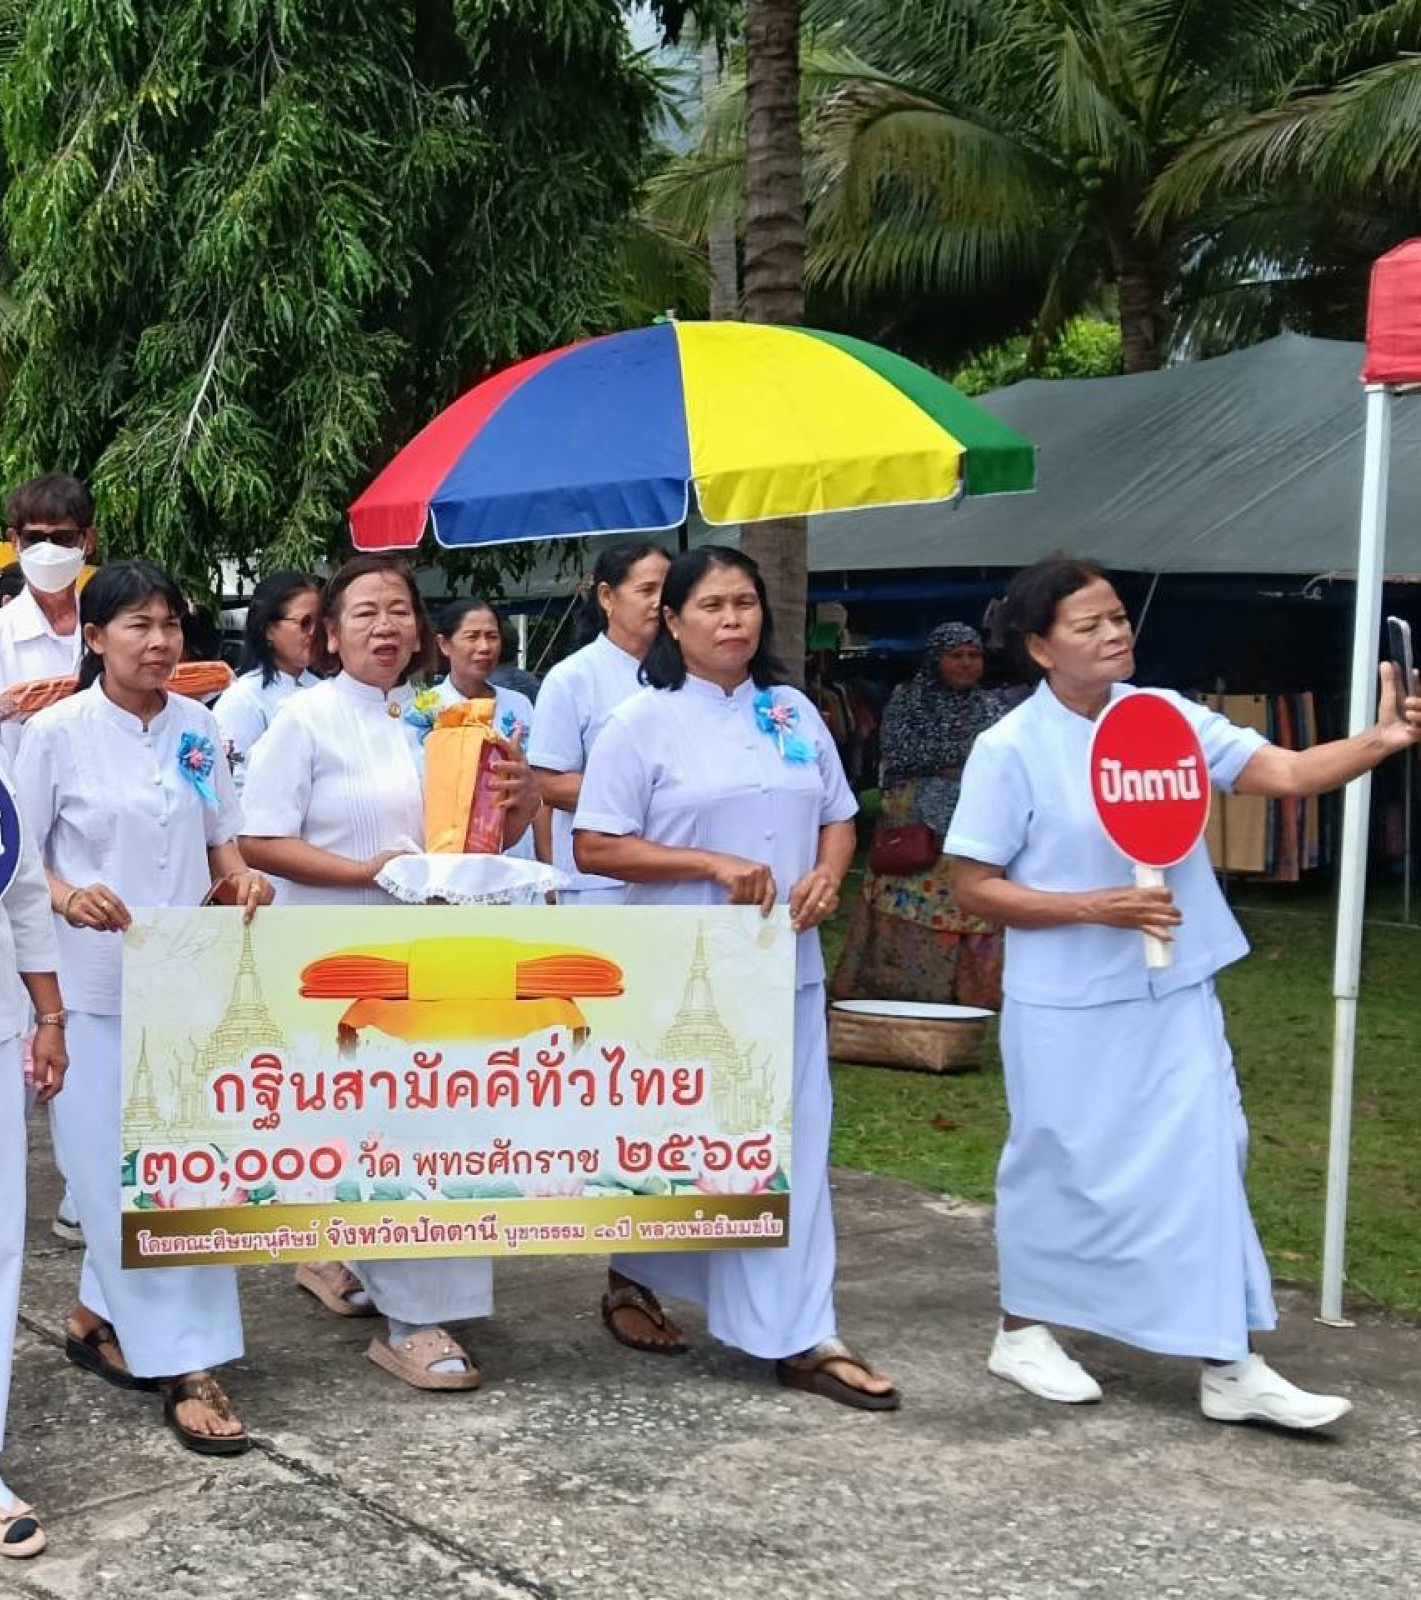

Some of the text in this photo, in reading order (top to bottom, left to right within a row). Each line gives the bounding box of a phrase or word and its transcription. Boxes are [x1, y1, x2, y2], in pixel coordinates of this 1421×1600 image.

[1100, 755, 1201, 803] ปัตตานี
[213, 1033, 705, 1131] กฐินสามัคคีทั่วไทย
[358, 1140, 401, 1178] วัด
[413, 1138, 600, 1190] พุทธศักราช
[616, 1133, 772, 1174] ๒๕๖๘
[138, 1220, 317, 1258] โดยคณะศิษยานุศิษย์
[326, 1213, 498, 1246] จังหวัดปัตตานี
[504, 1225, 586, 1247] บูชาธรรม
